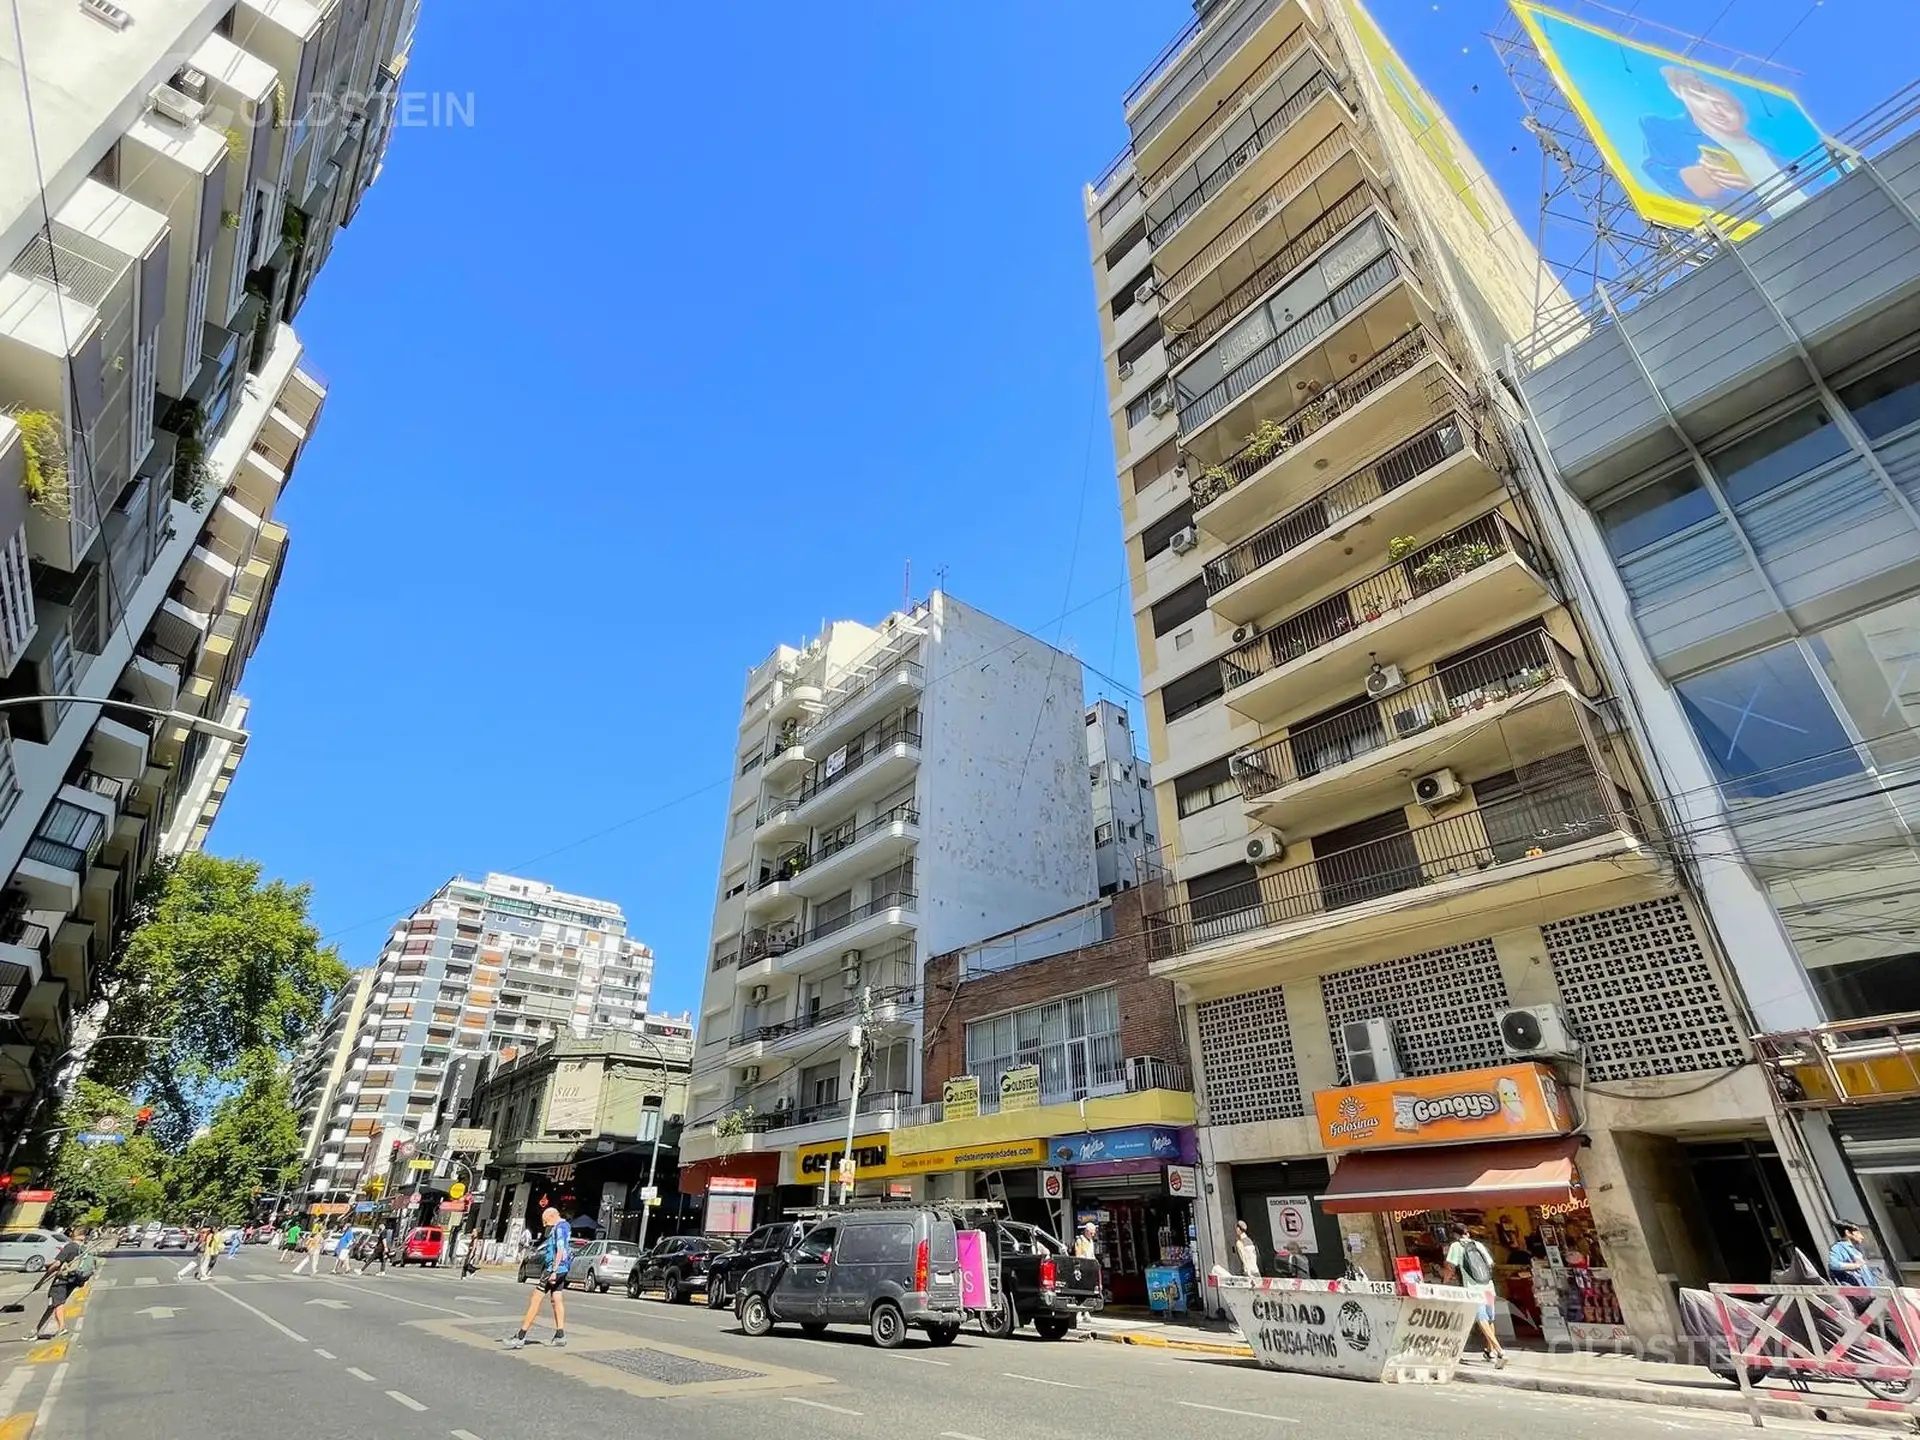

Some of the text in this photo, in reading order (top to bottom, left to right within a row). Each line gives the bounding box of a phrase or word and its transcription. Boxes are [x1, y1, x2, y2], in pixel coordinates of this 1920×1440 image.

[1000, 1074, 1038, 1093] GOLDSTEIN
[944, 1086, 978, 1102] GOLDSTEIN
[1413, 1093, 1497, 1123] Gongys
[1329, 1117, 1379, 1138] Golosinas
[1080, 1139, 1105, 1160] Milka
[1152, 1135, 1172, 1151] Milka
[954, 1146, 1034, 1165] goldsteinpropiedades.com
[1284, 1213, 1298, 1232] E
[1370, 1283, 1393, 1294] 1315
[1252, 1299, 1326, 1326] CIUDAD
